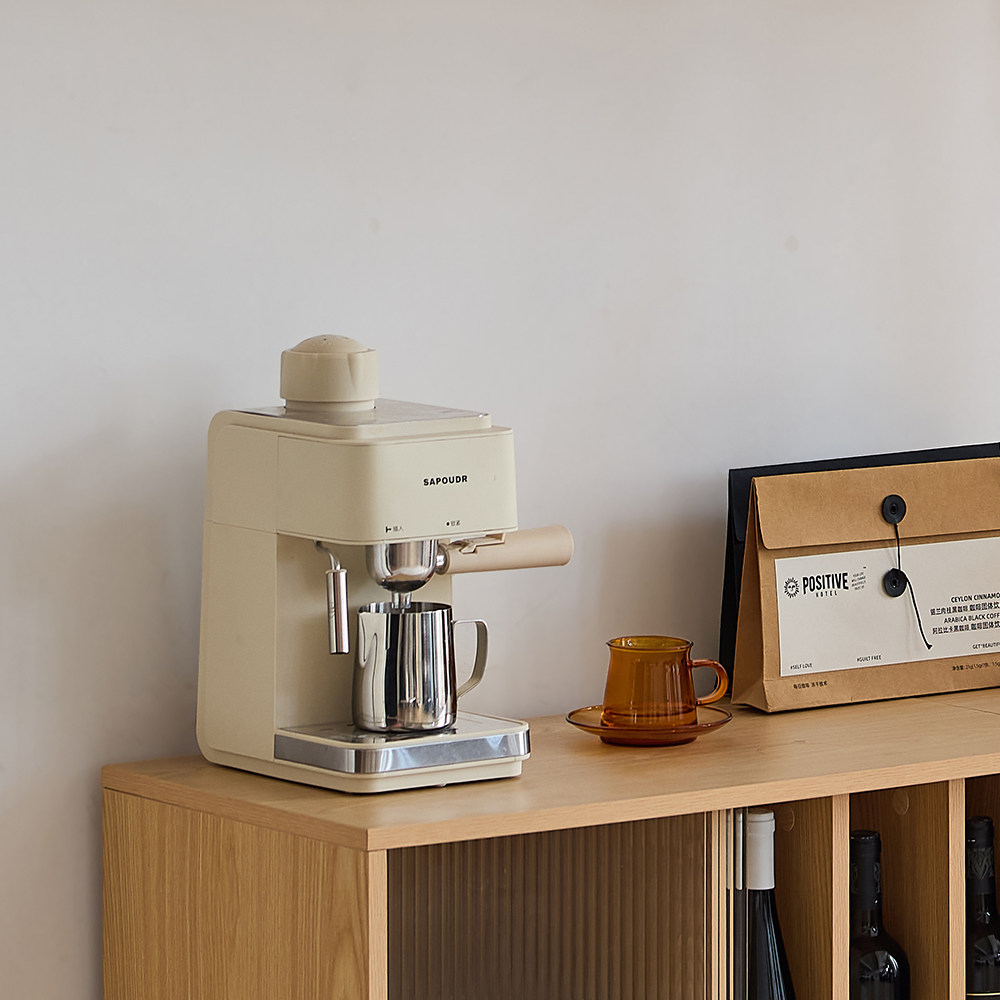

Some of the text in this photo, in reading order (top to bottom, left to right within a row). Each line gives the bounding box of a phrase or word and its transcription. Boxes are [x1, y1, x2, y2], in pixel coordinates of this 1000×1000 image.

[423, 475, 468, 486] SAPOUDR
[802, 572, 849, 595] POSITIVE
[951, 595, 972, 603] CEYLON
[944, 615, 968, 623] ARABICA
